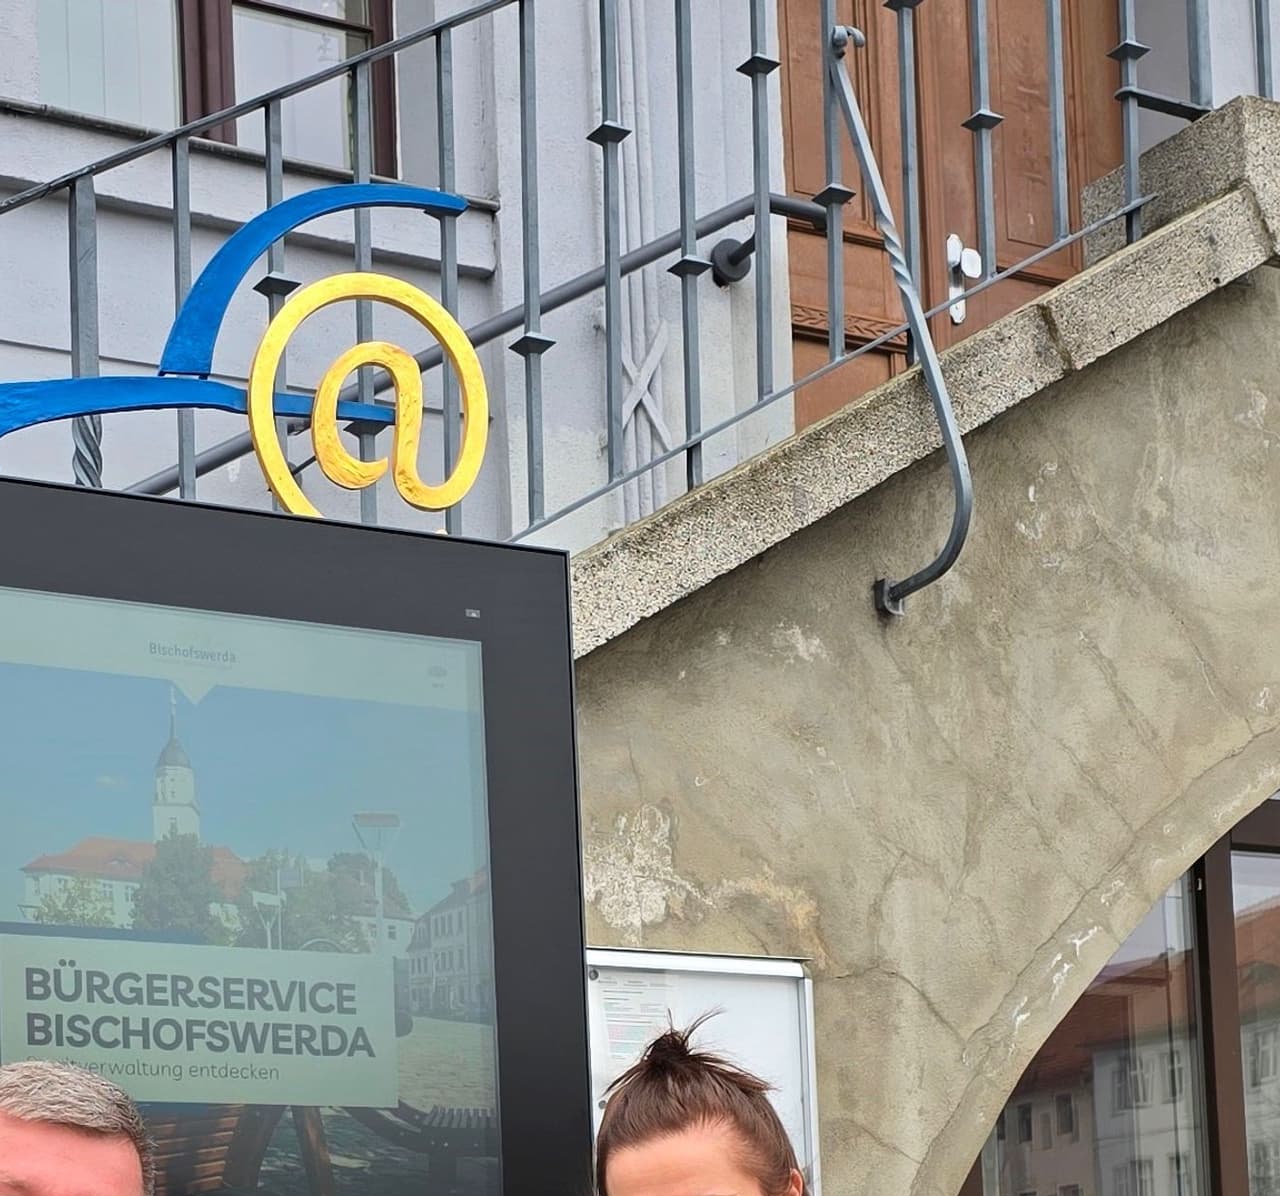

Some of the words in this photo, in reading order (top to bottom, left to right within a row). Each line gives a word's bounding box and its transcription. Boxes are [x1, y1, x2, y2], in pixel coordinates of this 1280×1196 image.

[148, 642, 237, 664] Bischofswerda
[25, 959, 358, 1016] BÜRGERSERVICE
[26, 1014, 376, 1059] BISCHOFSWERDA
[188, 1062, 280, 1080] entdecken
